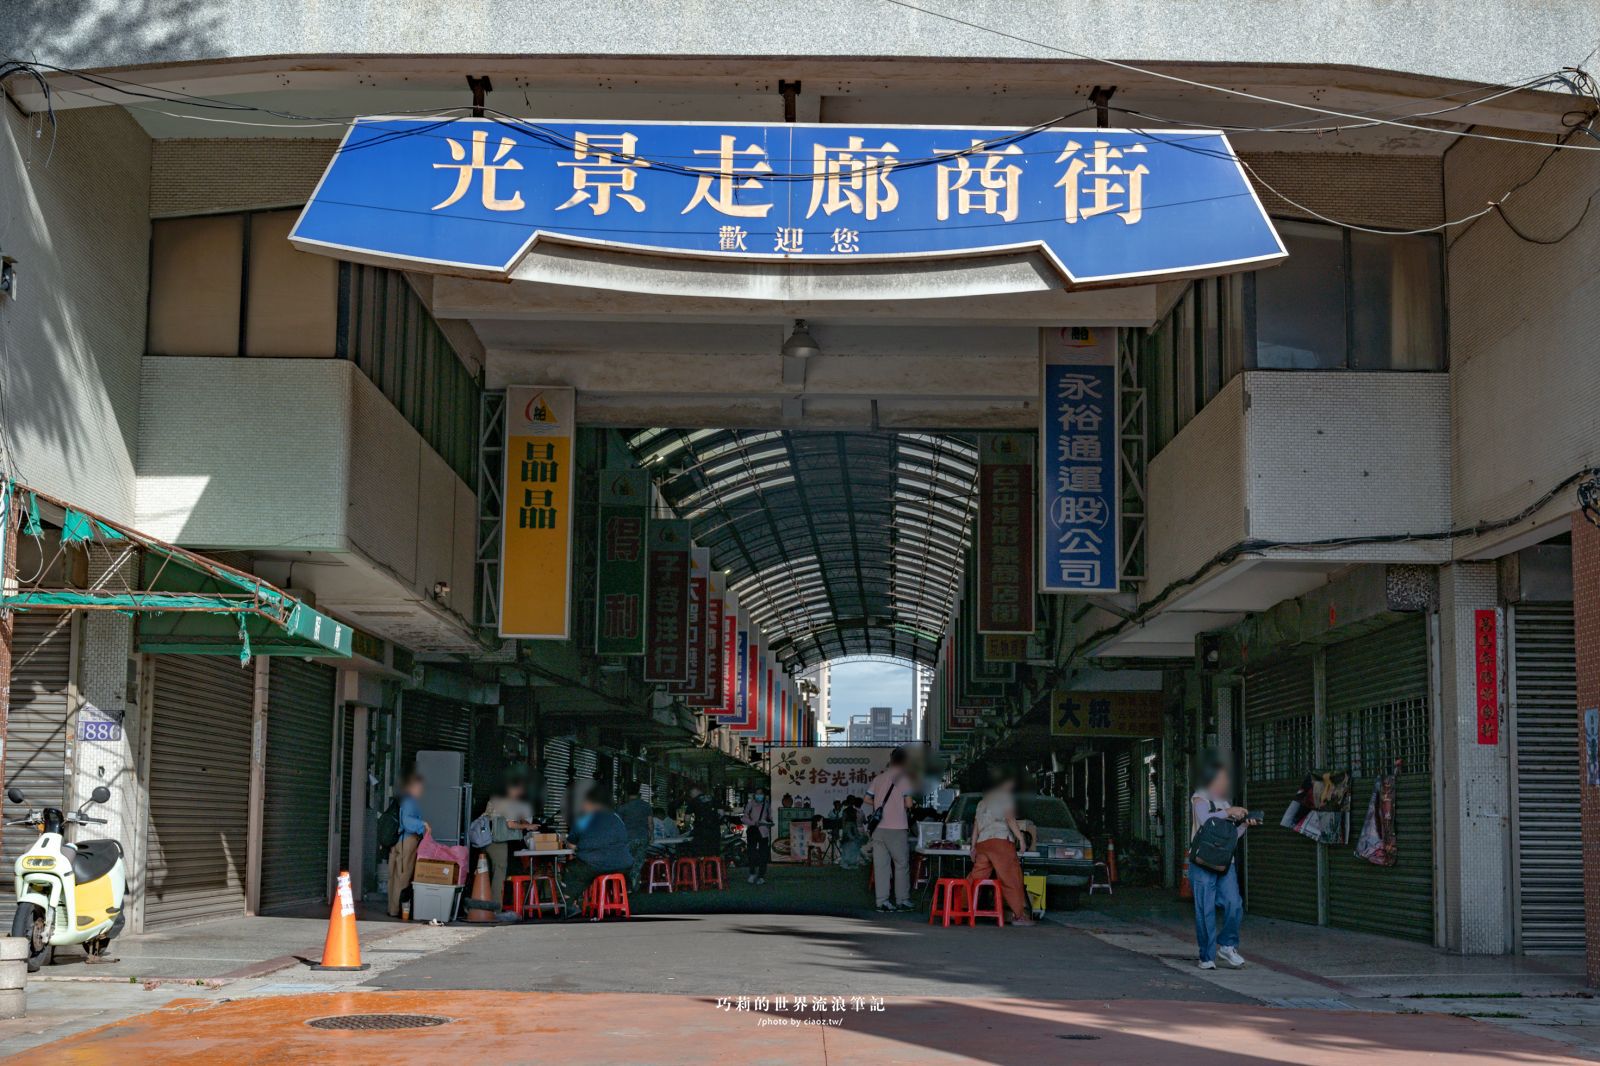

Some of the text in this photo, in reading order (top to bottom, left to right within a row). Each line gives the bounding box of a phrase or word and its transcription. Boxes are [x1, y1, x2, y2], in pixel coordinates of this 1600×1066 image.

[431, 130, 1150, 225] 光景走廊商街
[718, 225, 861, 254] 歡迎您
[520, 441, 558, 529] 晶晶
[809, 767, 884, 787] 拾光補
